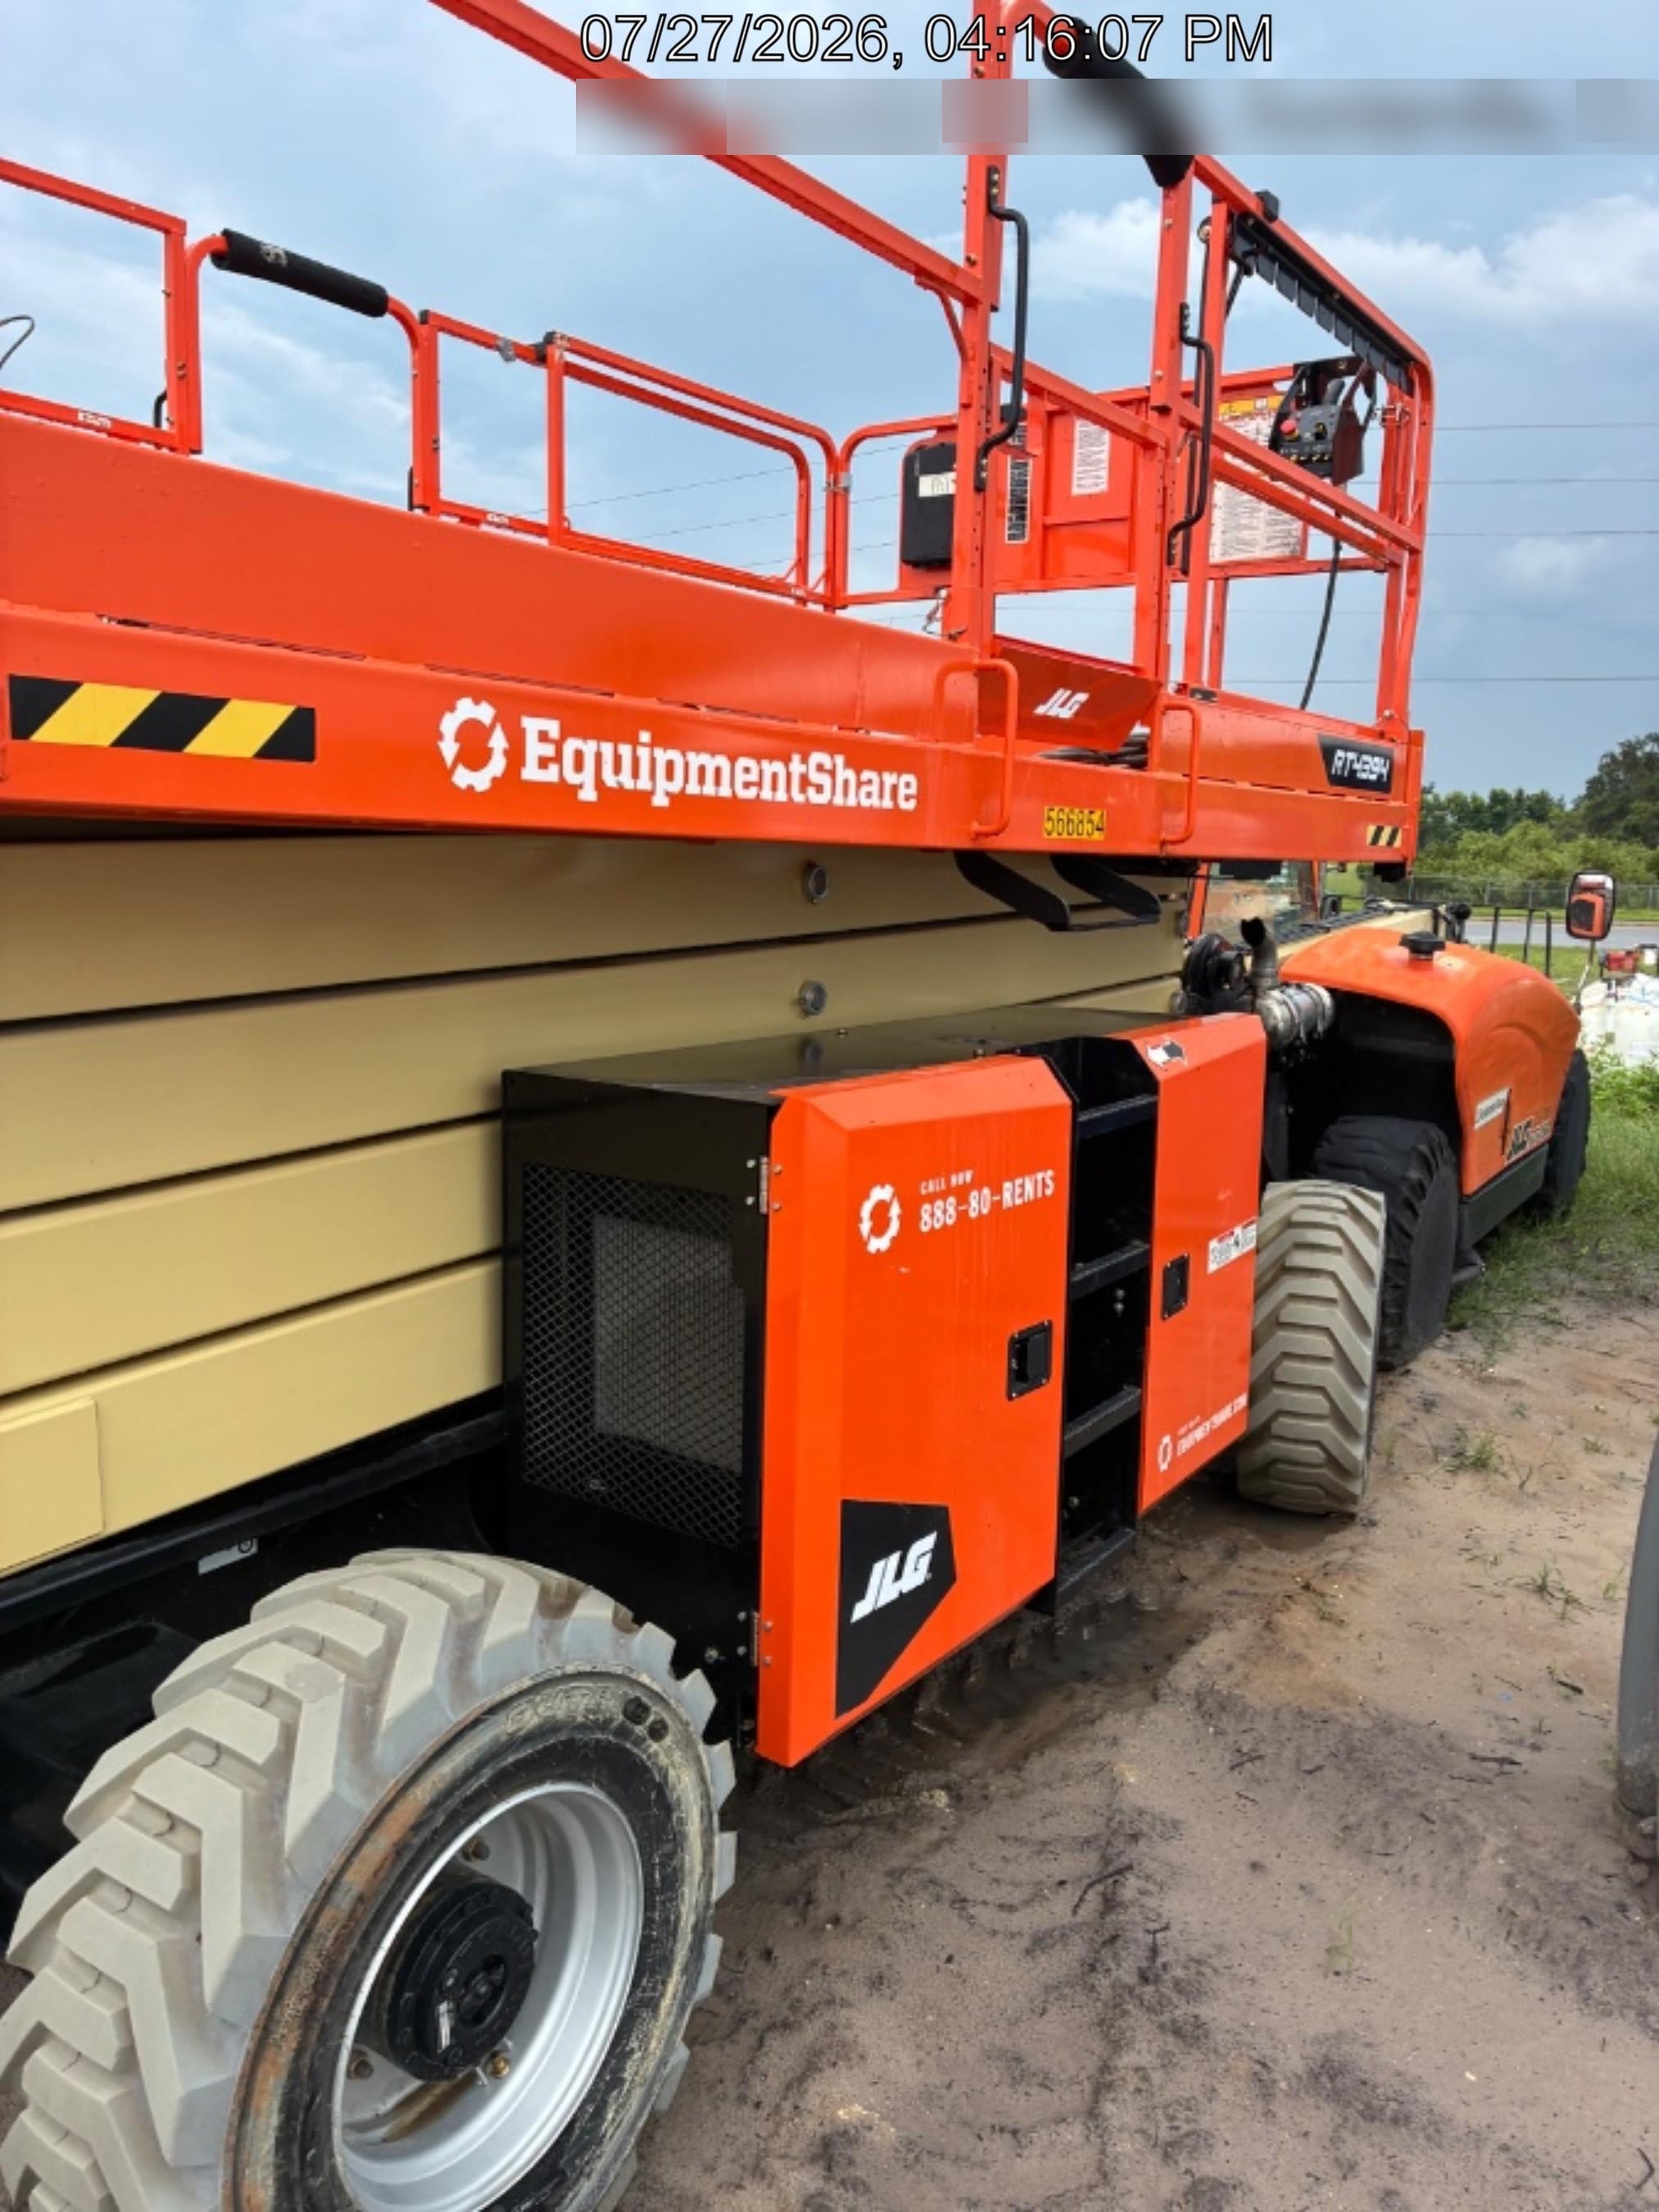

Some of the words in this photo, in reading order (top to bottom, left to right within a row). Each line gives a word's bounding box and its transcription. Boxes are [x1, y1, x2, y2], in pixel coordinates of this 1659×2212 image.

[1033, 687, 1090, 719] JLG
[520, 715, 918, 811] EquipmentShare
[1045, 808, 1104, 836] 566854
[919, 1169, 1055, 1232] 888-80-RENTS
[920, 1178, 945, 1194] CALL
[850, 1530, 937, 1625] JLG
